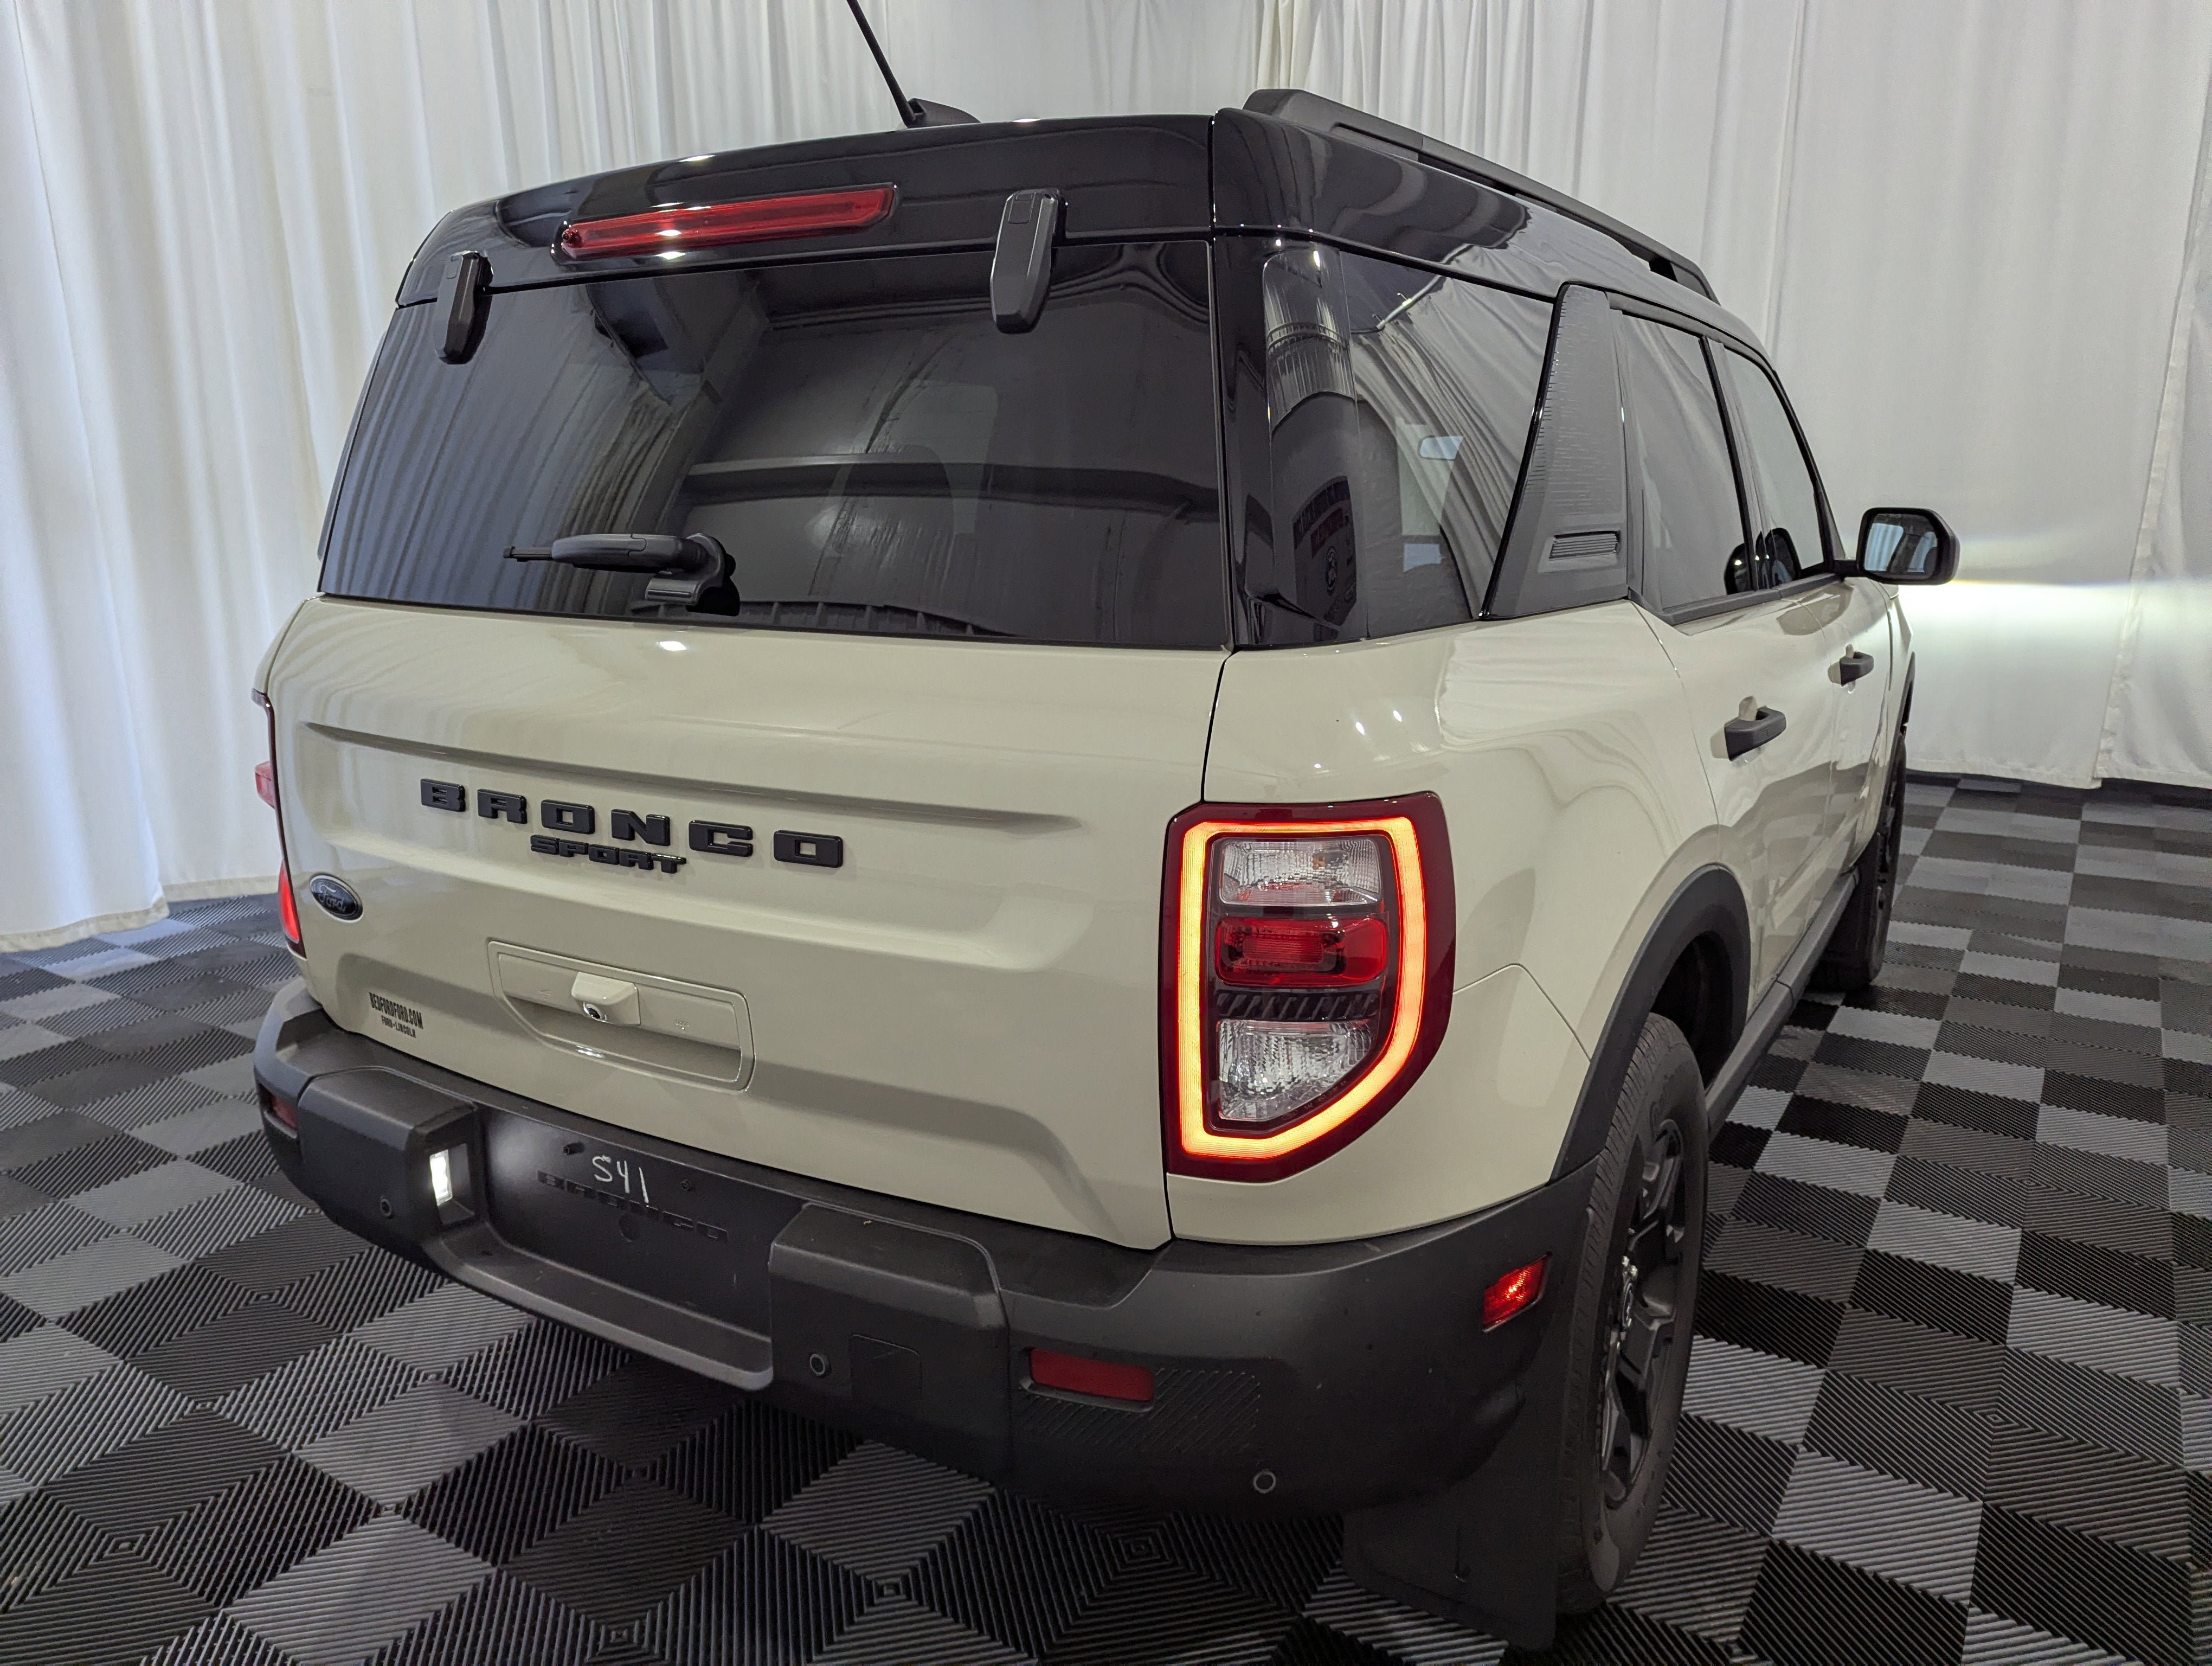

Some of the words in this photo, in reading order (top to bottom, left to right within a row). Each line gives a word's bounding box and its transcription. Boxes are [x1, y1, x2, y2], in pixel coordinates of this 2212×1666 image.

[420, 778, 844, 868] BRONCO
[530, 834, 686, 874] SPORT
[318, 884, 346, 913] Ford
